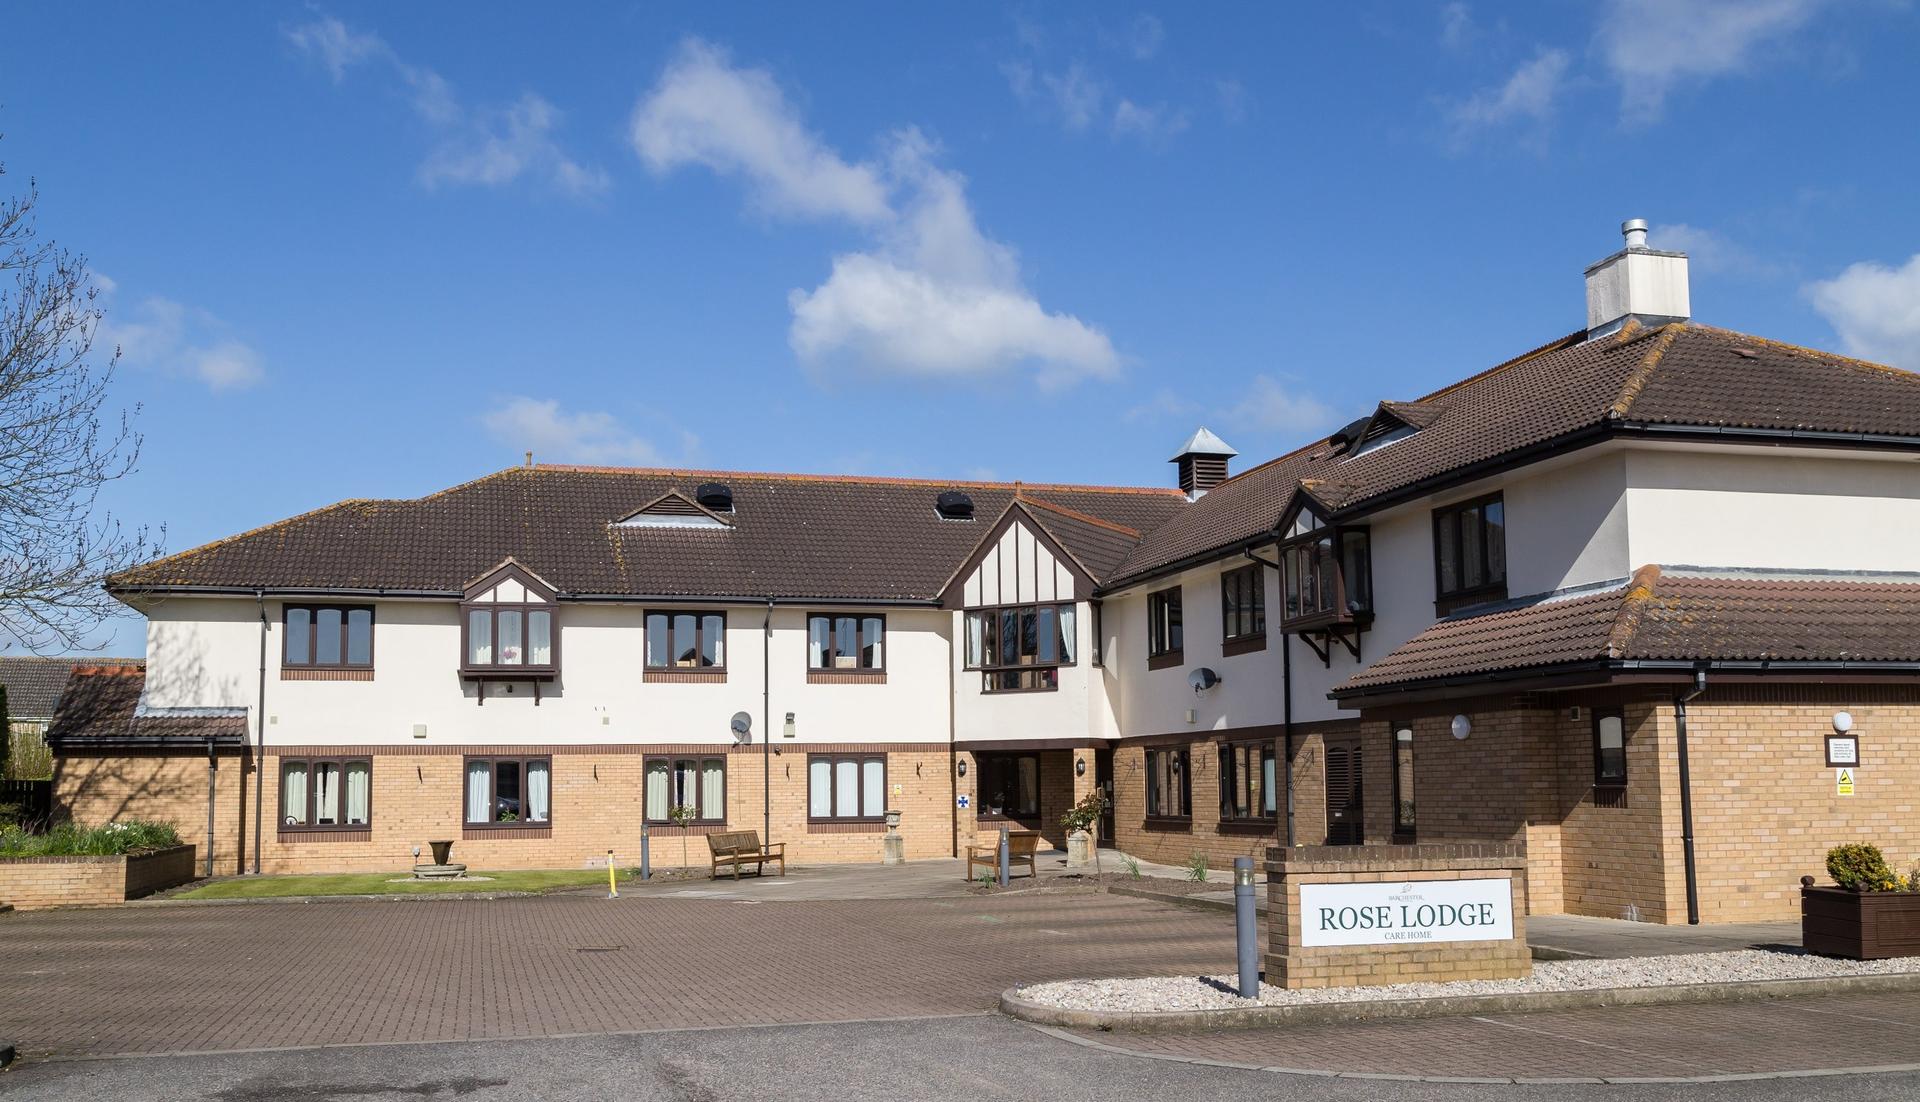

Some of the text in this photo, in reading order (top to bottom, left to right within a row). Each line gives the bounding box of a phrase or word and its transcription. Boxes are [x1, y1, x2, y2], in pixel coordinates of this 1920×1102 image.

[1319, 903, 1495, 931] ROSE LODGE
[1384, 930, 1433, 940] CARE HOME
